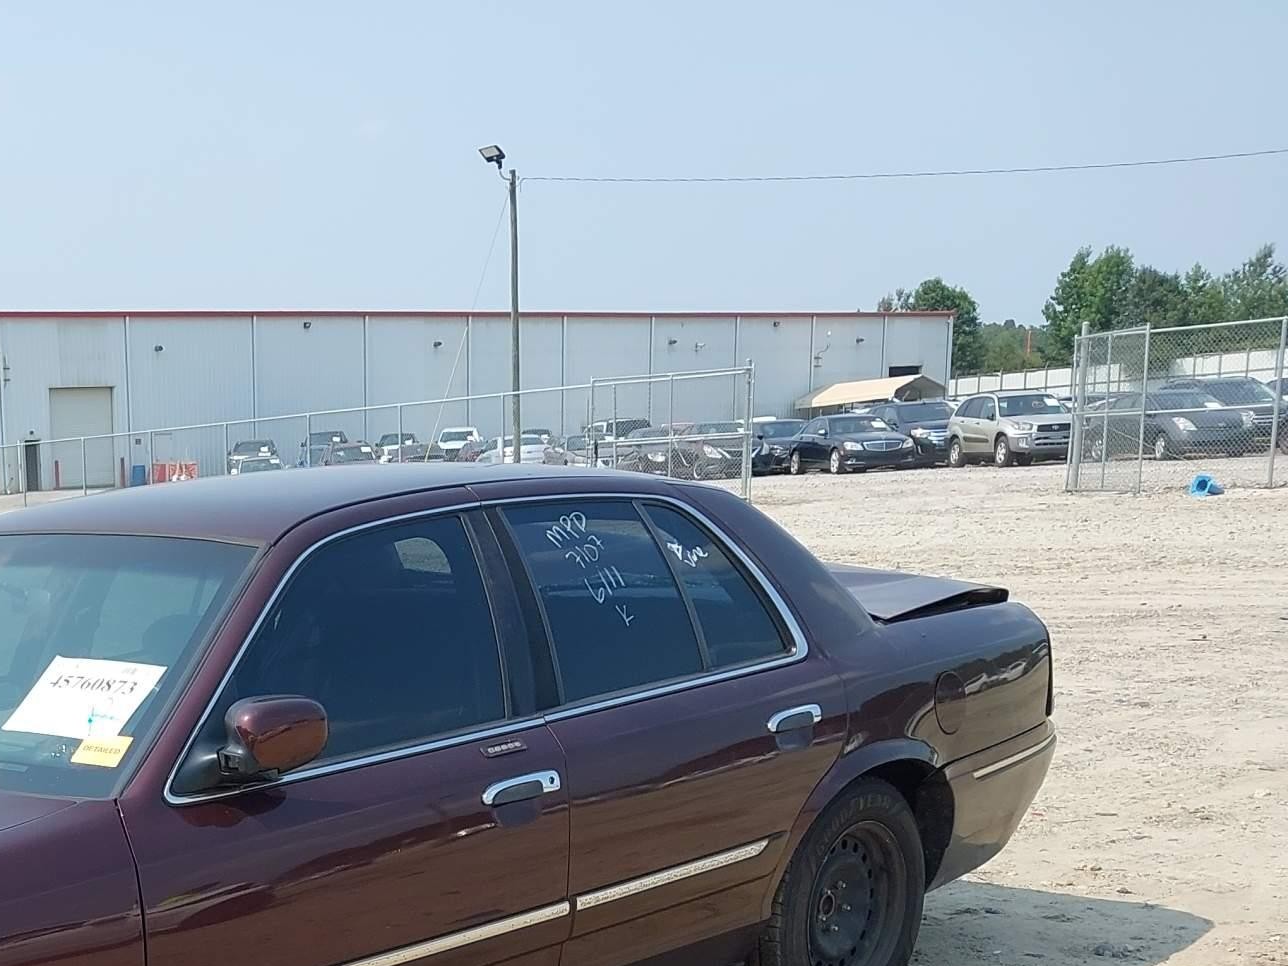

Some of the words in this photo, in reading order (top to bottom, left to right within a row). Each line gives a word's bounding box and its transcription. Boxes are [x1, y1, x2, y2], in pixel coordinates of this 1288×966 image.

[546, 511, 587, 548] MPD
[49, 674, 139, 695] 45760873
[82, 744, 122, 755] DETAILED
